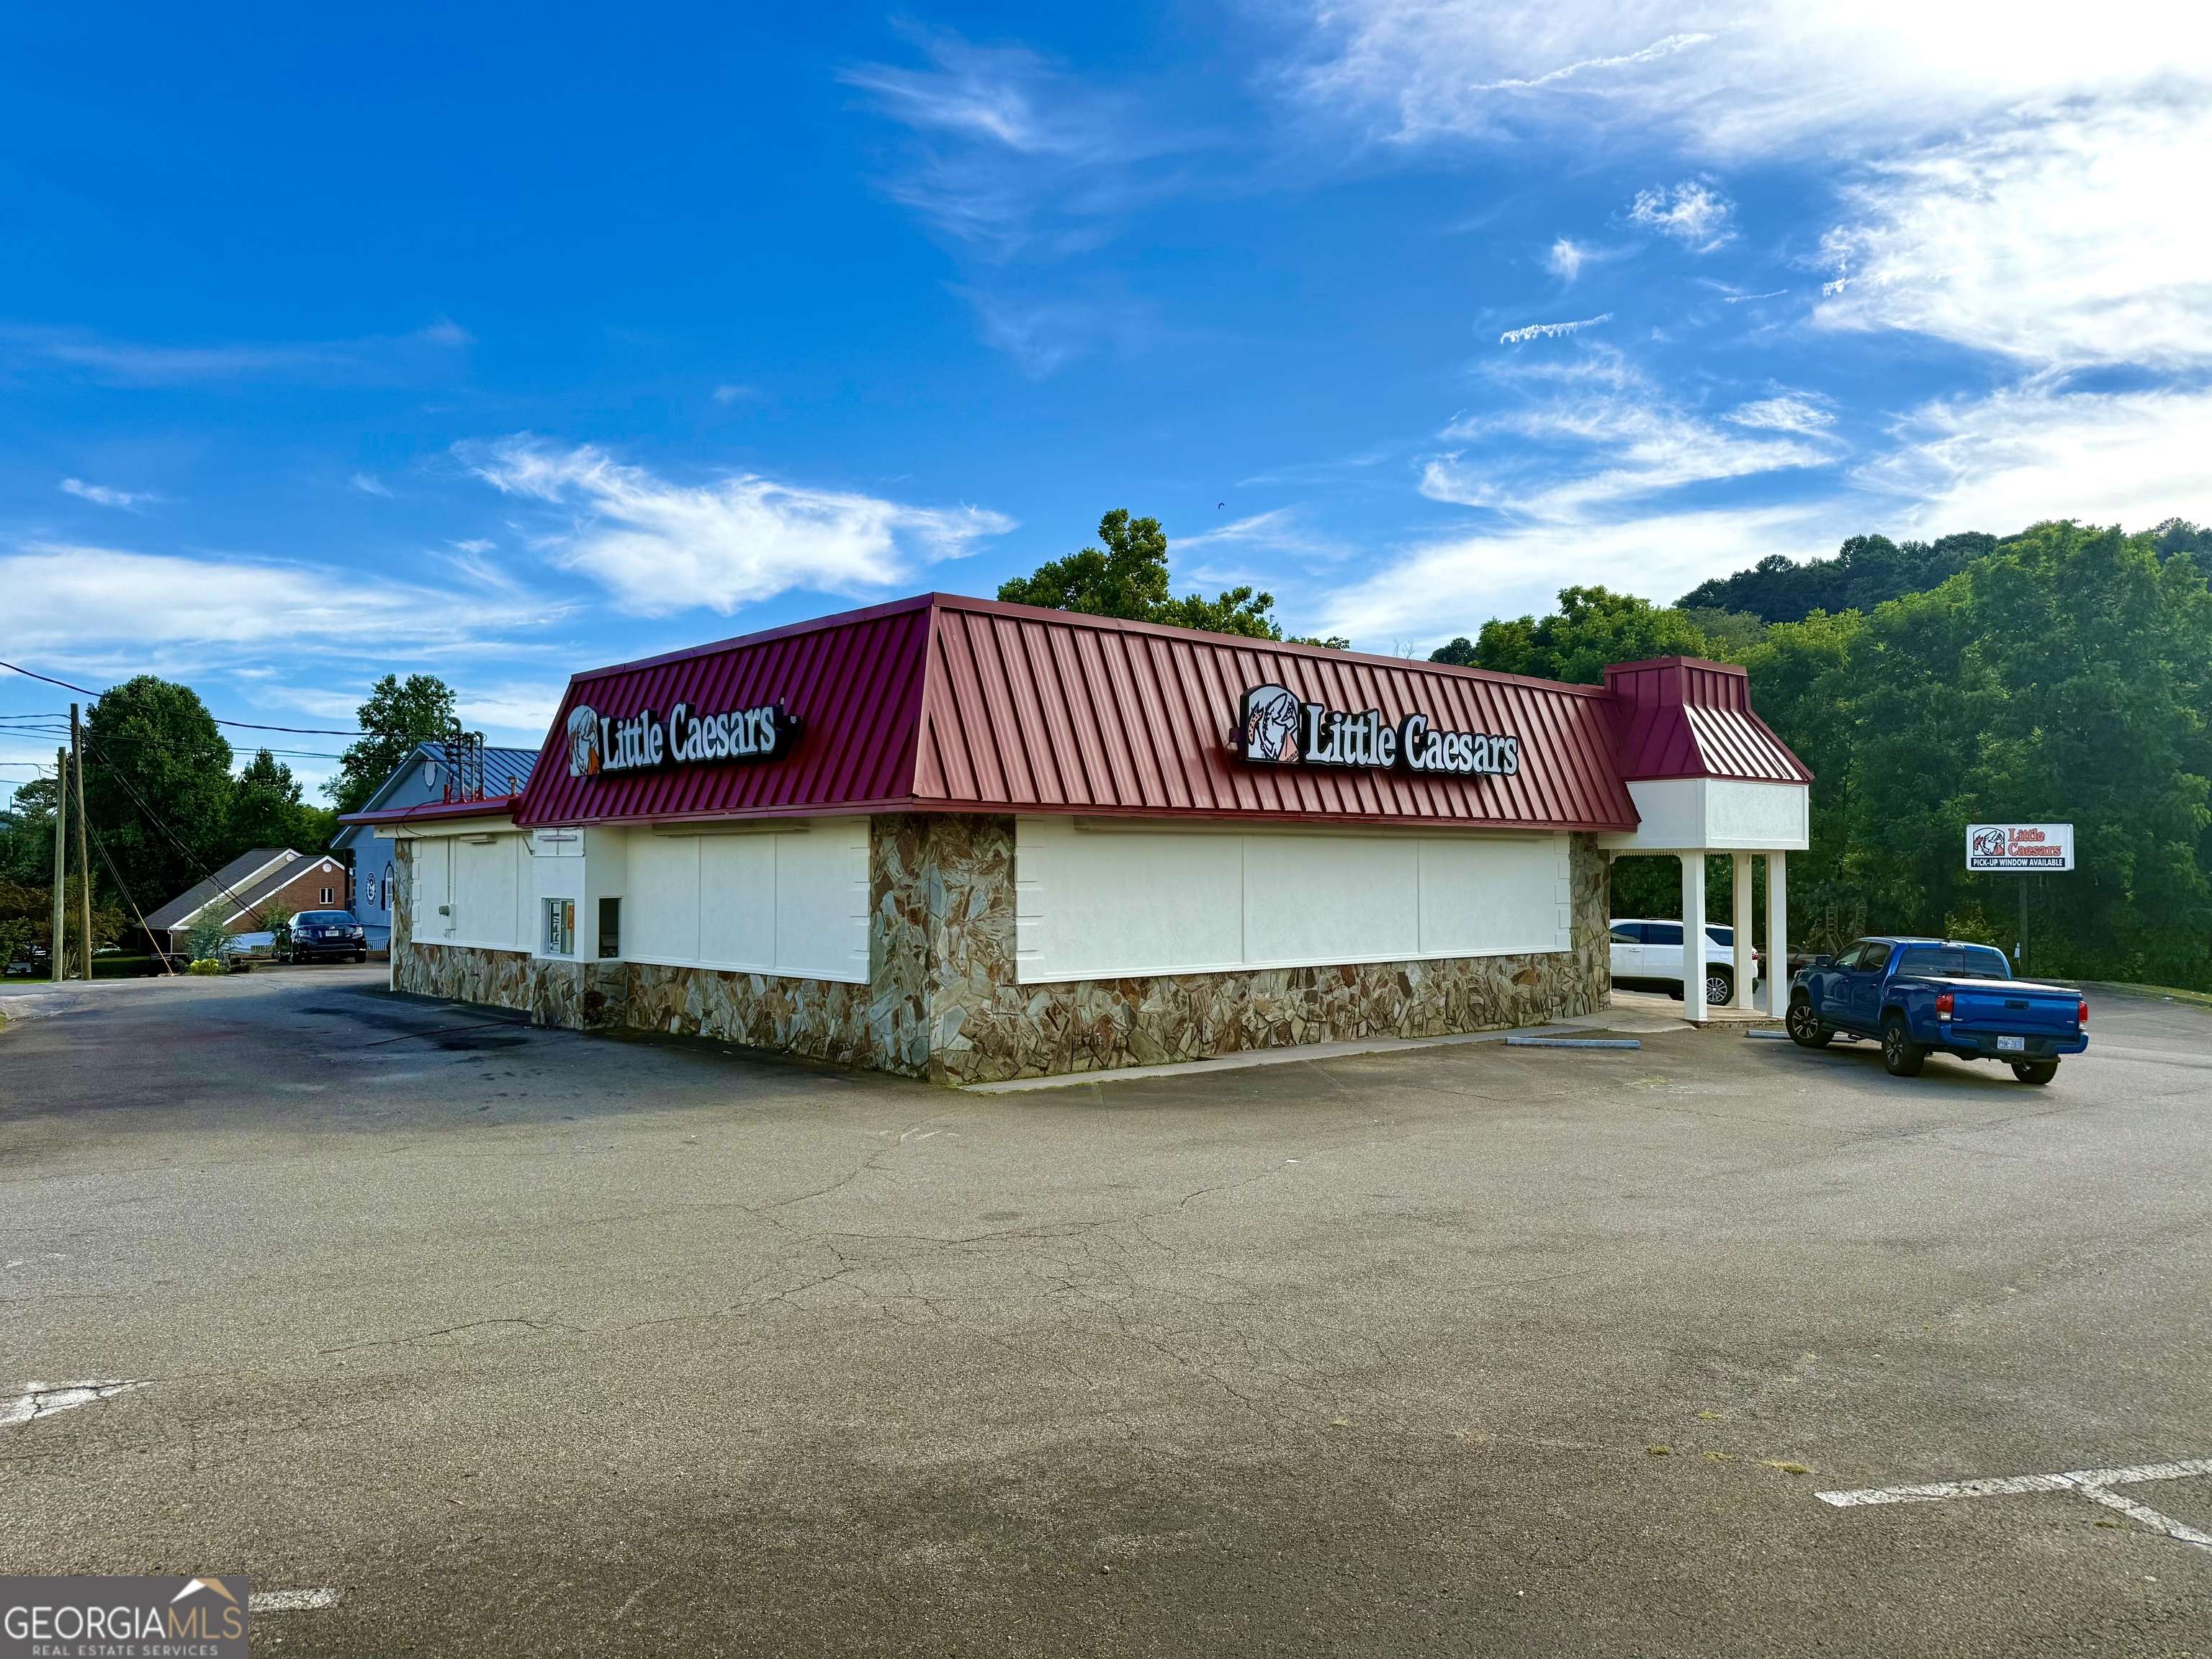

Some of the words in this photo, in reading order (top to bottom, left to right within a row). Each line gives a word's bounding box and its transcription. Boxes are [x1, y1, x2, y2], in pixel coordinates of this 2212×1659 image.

[601, 709, 664, 770] Little
[670, 701, 776, 762] Caesars
[1305, 704, 1396, 768] Little
[1404, 715, 1518, 775] Caesars
[2008, 828, 2045, 842] Little
[2008, 842, 2062, 856] Caesars
[1973, 858, 1998, 867] PICK-UP
[2000, 858, 2028, 867] WINDOW
[2029, 858, 2063, 867] AVAILABLE
